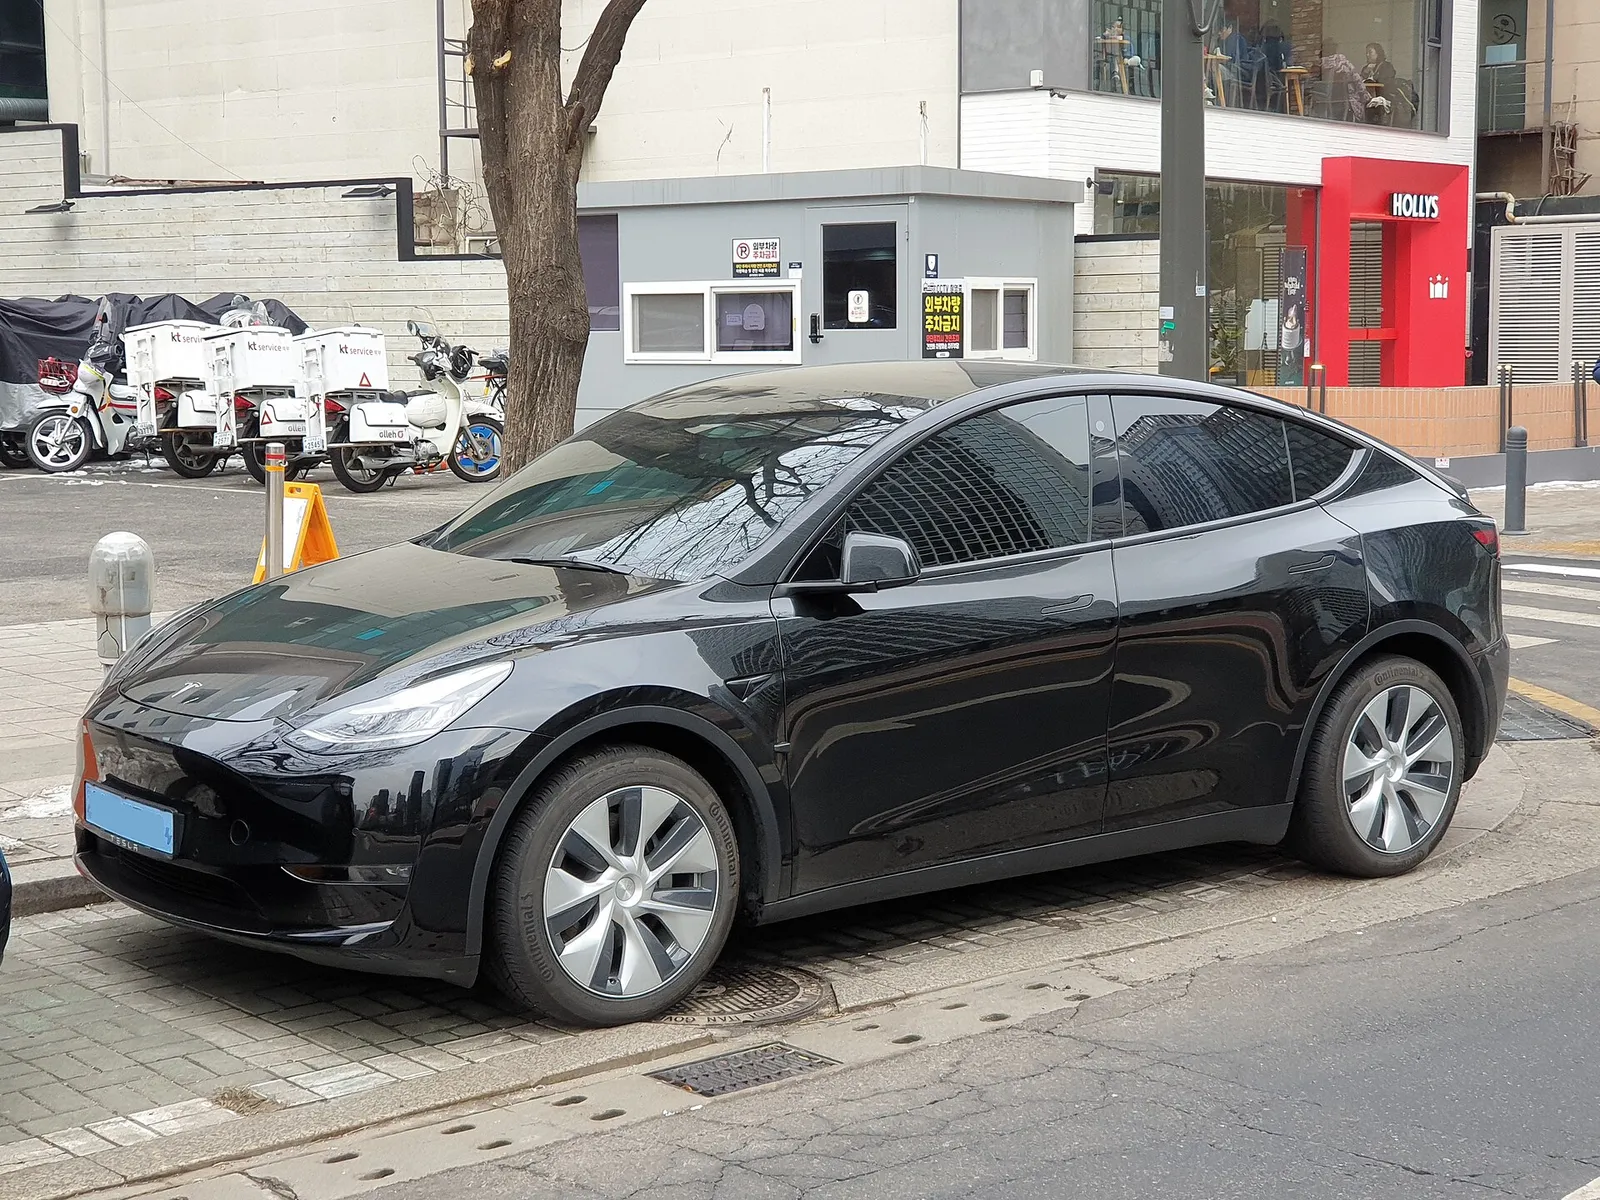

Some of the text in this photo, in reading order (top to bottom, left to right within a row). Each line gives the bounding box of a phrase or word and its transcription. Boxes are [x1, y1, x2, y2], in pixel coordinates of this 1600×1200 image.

[1392, 192, 1439, 218] HOLLYS
[752, 241, 778, 250] 외부차량
[752, 250, 778, 260] 주차금지
[925, 295, 961, 313] 외부차량
[925, 315, 960, 332] 주차금지
[171, 331, 181, 343] kt
[247, 341, 257, 351] kt
[258, 343, 282, 352] service
[339, 344, 348, 354] kt
[349, 346, 373, 356] service
[379, 429, 396, 438] olleh
[1374, 666, 1419, 686] Continental
[109, 834, 139, 852] TESLA
[708, 801, 737, 877] Continental
[520, 904, 554, 983] Continental
